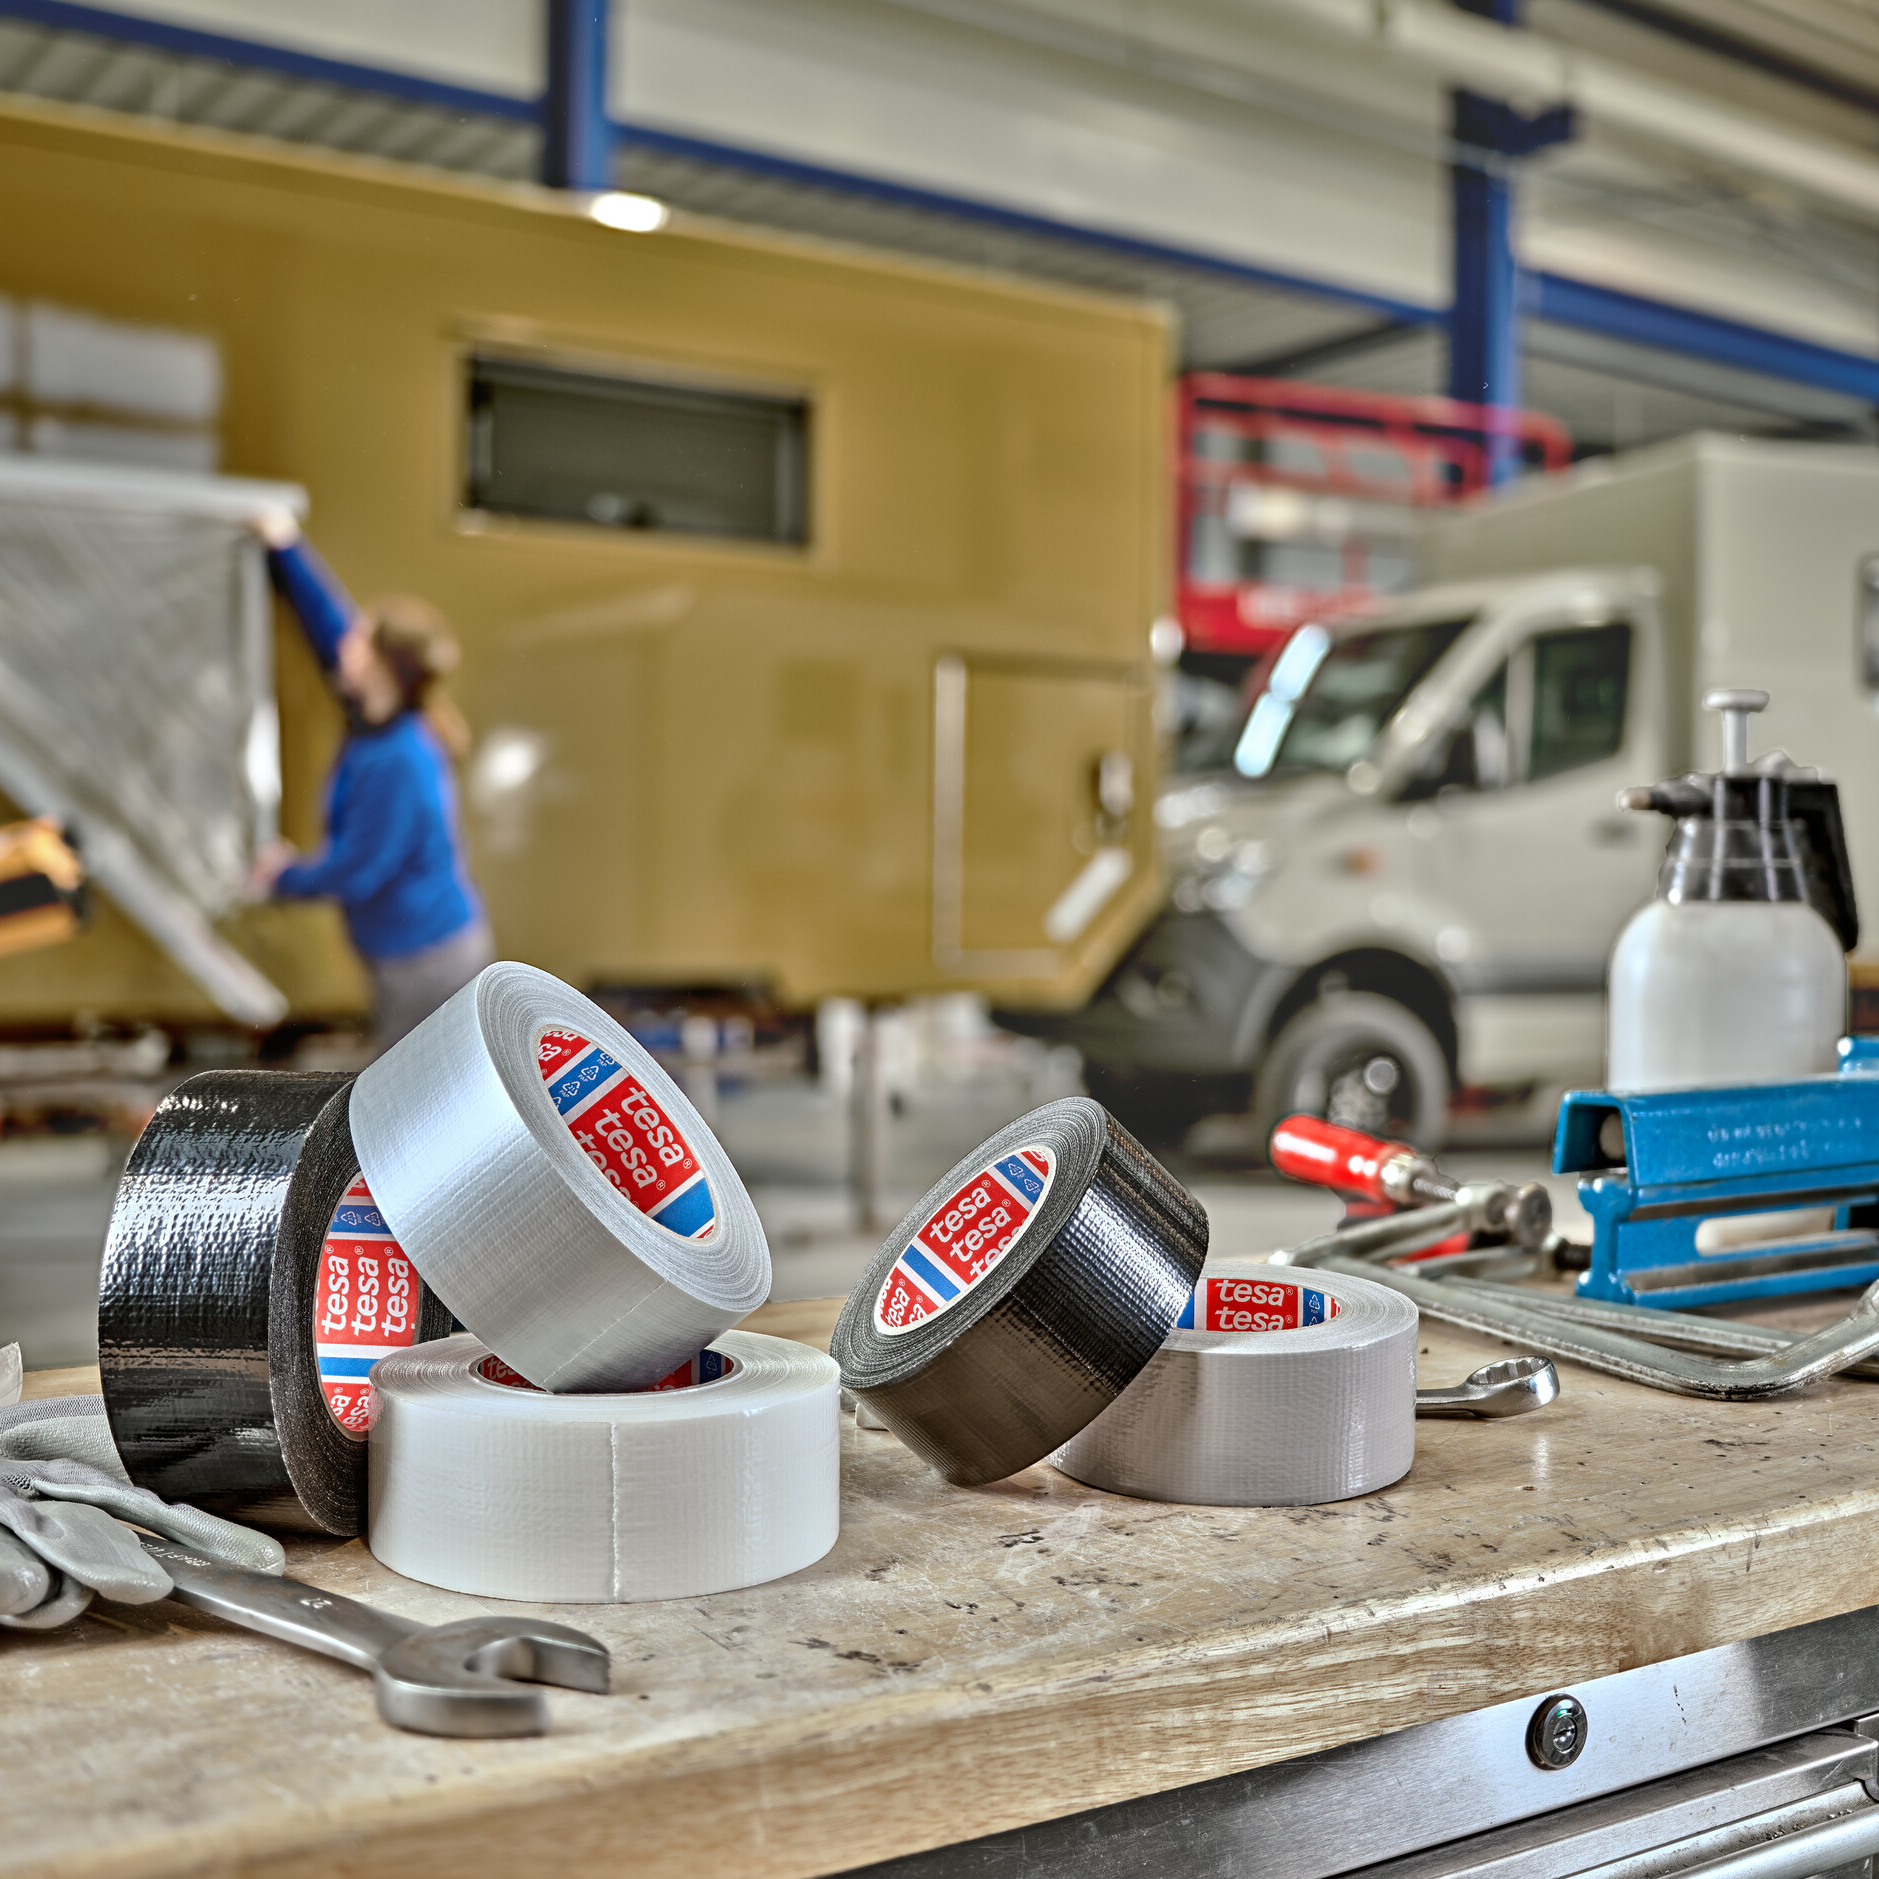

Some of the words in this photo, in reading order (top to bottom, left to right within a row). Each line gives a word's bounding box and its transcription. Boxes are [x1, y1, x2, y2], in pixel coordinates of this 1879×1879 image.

[595, 1108, 657, 1189] tesa
[621, 1087, 684, 1168] tesa
[929, 1186, 991, 1243] tesa
[950, 1206, 1012, 1262] tesa
[321, 1256, 349, 1335] tesa
[351, 1256, 379, 1336] tesa
[381, 1257, 409, 1337] tesa
[1215, 1280, 1284, 1306] tesa
[1215, 1306, 1284, 1330] tesa
